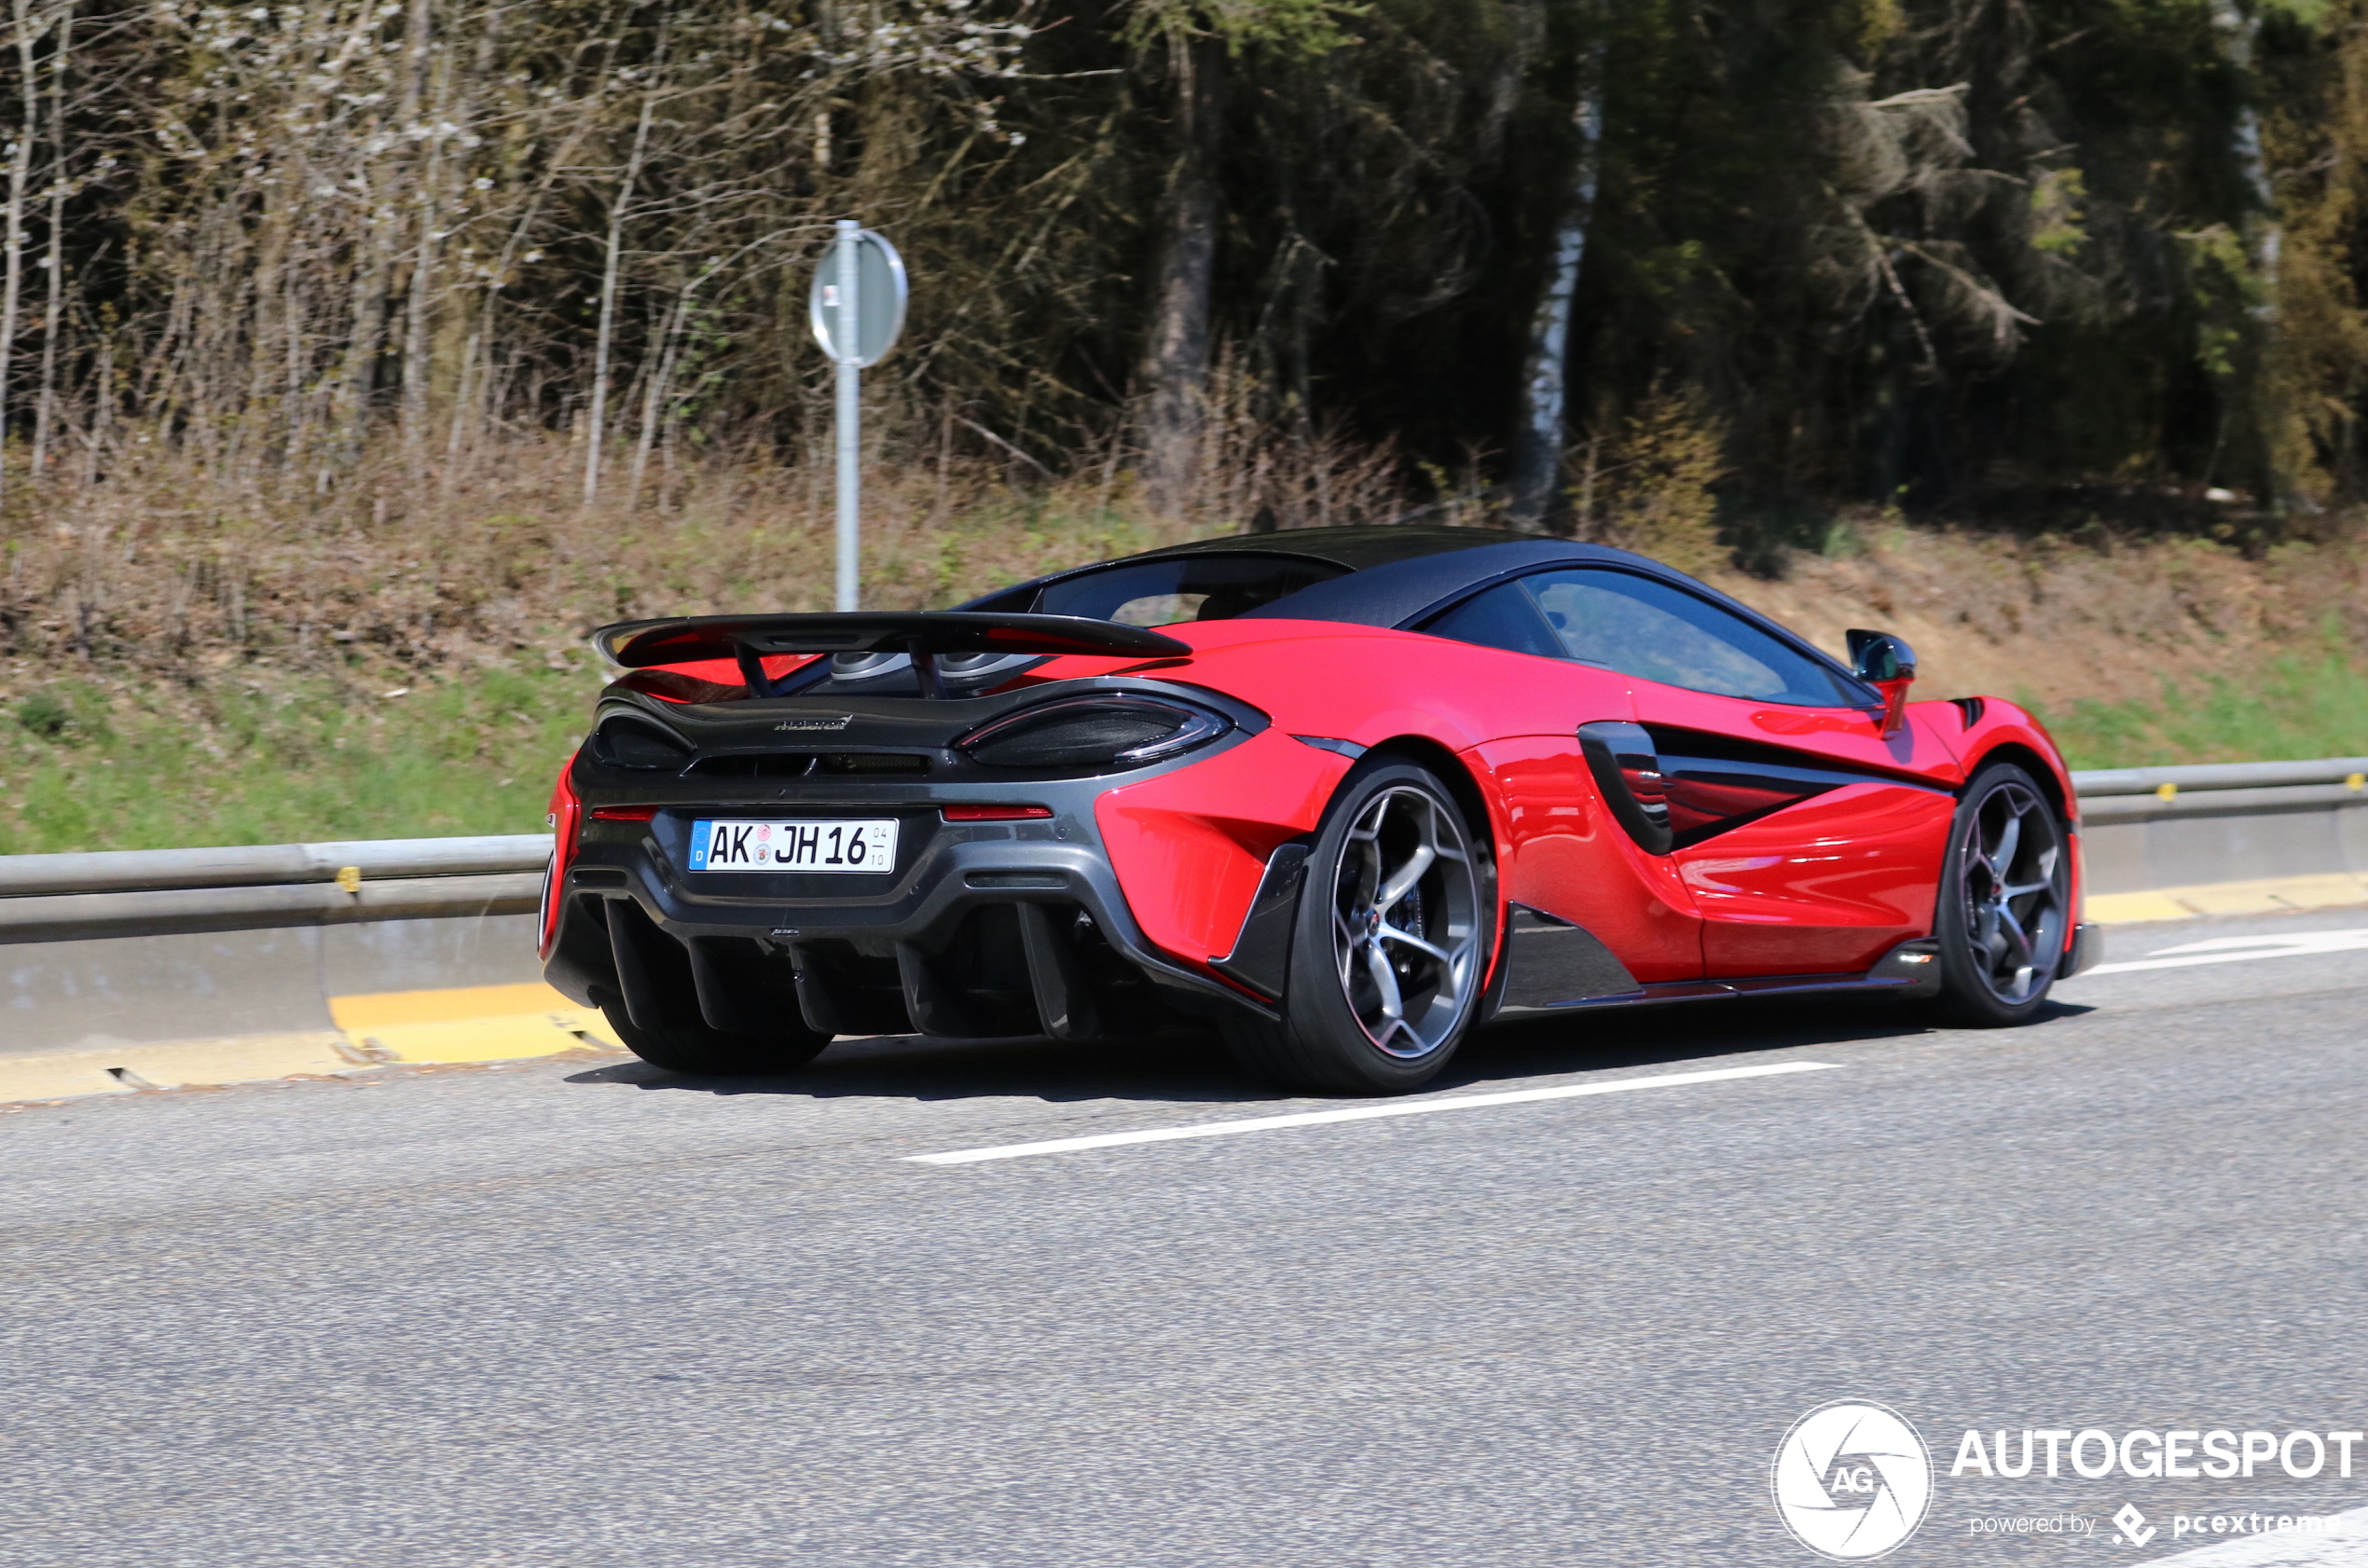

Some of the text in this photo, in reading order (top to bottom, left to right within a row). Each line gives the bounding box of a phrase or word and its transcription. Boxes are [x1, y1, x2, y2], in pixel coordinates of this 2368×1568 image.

[874, 827, 888, 838] 04
[709, 826, 867, 865] AK JH 16
[695, 850, 703, 861] D
[871, 854, 884, 865] 10
